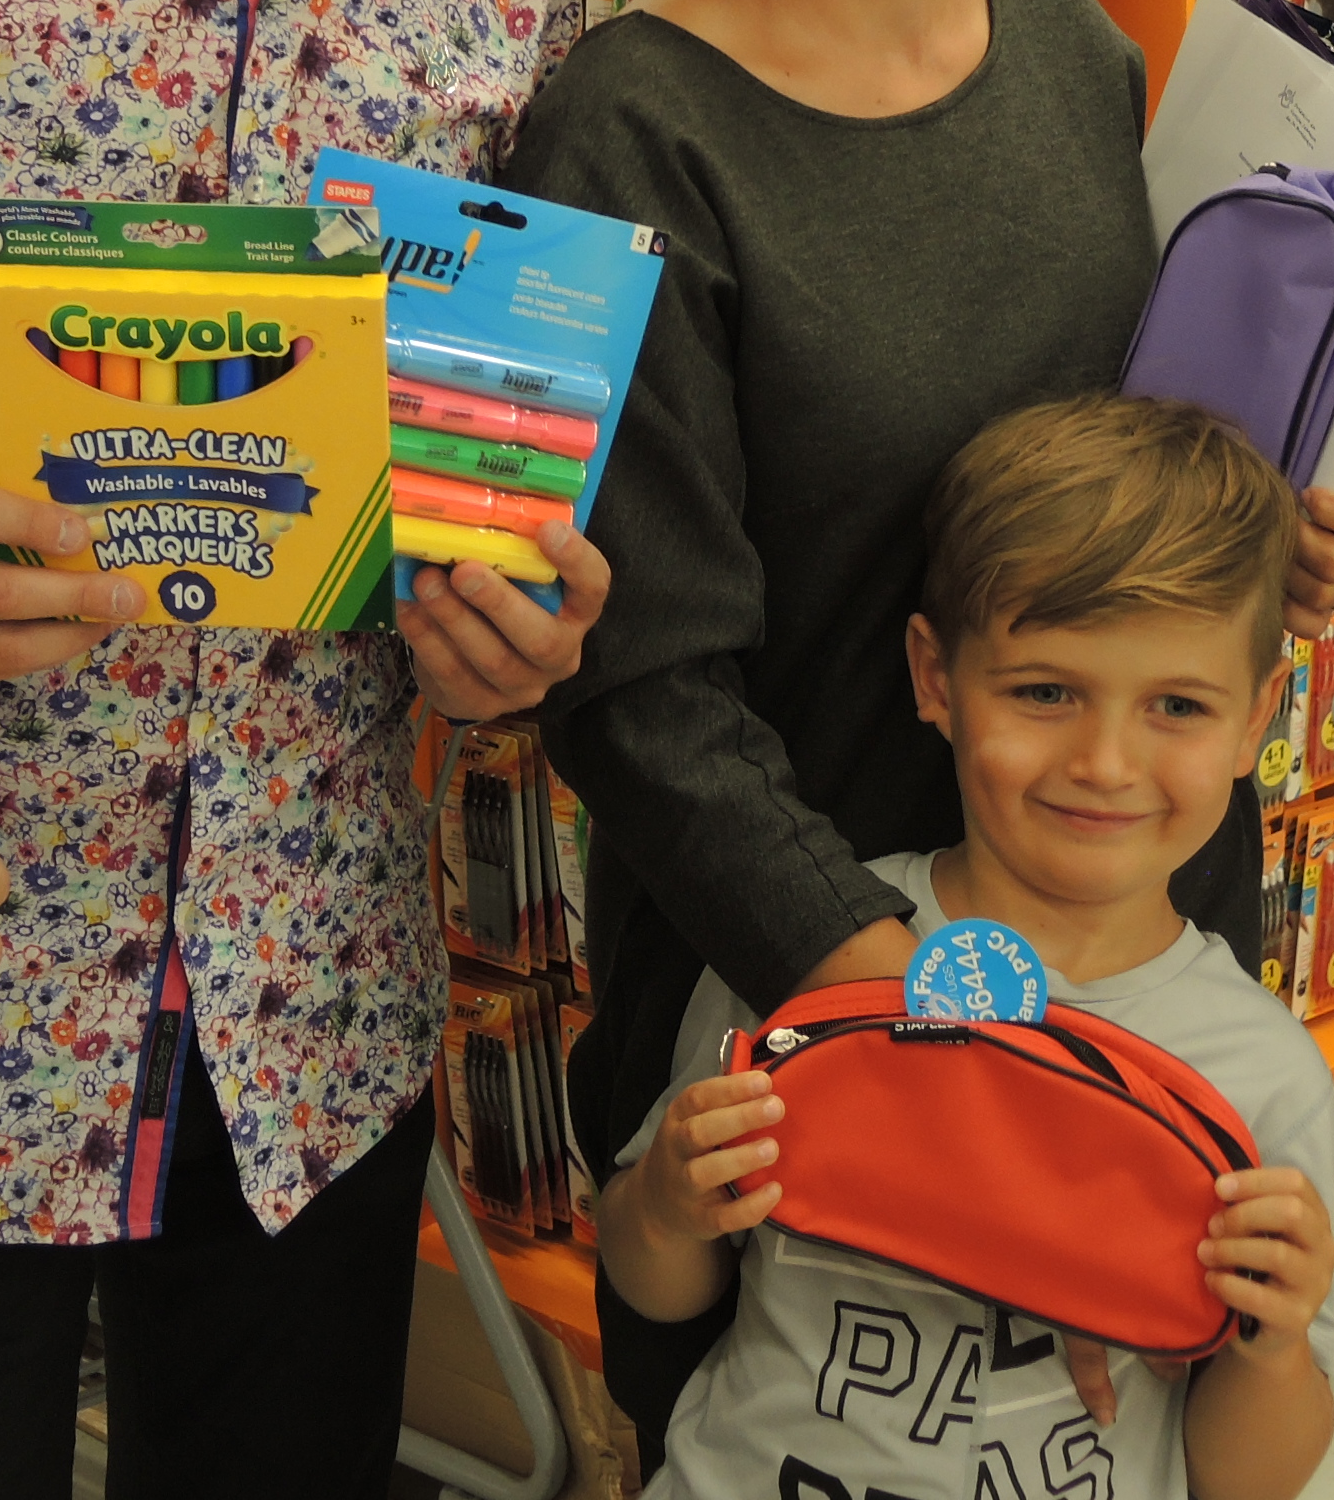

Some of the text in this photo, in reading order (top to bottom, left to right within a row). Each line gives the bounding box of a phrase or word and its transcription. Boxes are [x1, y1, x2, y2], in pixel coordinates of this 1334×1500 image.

[325, 183, 372, 202] STAPLES
[40, 206, 77, 219] Washable
[5, 229, 49, 244] Classic
[49, 230, 100, 245] Colours
[243, 239, 295, 253] Broad Line
[636, 233, 647, 247] 5
[6, 243, 125, 262] couleurs classiques
[245, 250, 295, 265] Trait large
[49, 303, 285, 361] Crayola
[349, 315, 367, 327] 3+
[71, 428, 287, 467] ULTRA-CLEAN
[85, 473, 268, 501] Washable Lavables
[106, 504, 259, 544] MARKERS
[93, 536, 274, 580] MARQUEURS
[170, 581, 207, 611] 10
[913, 946, 947, 996] Free
[986, 930, 1038, 1022] ans PVC
